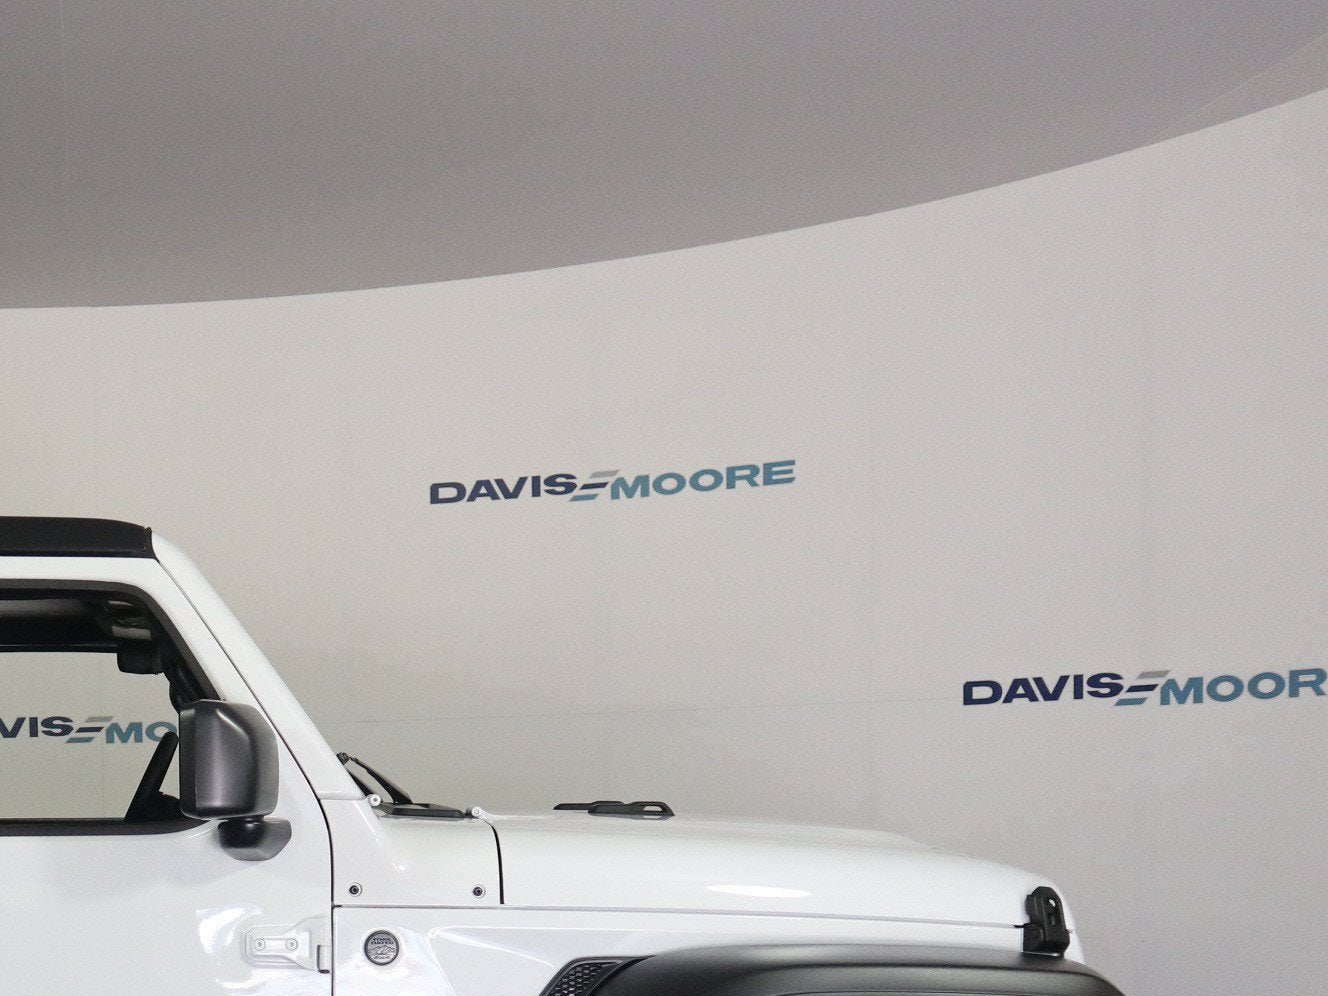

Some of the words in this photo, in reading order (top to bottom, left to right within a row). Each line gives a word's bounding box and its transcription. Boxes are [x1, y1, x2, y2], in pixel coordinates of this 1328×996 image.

[430, 473, 577, 504] DAVIS
[610, 460, 796, 500] MOORE
[963, 672, 1124, 706] DAVIS
